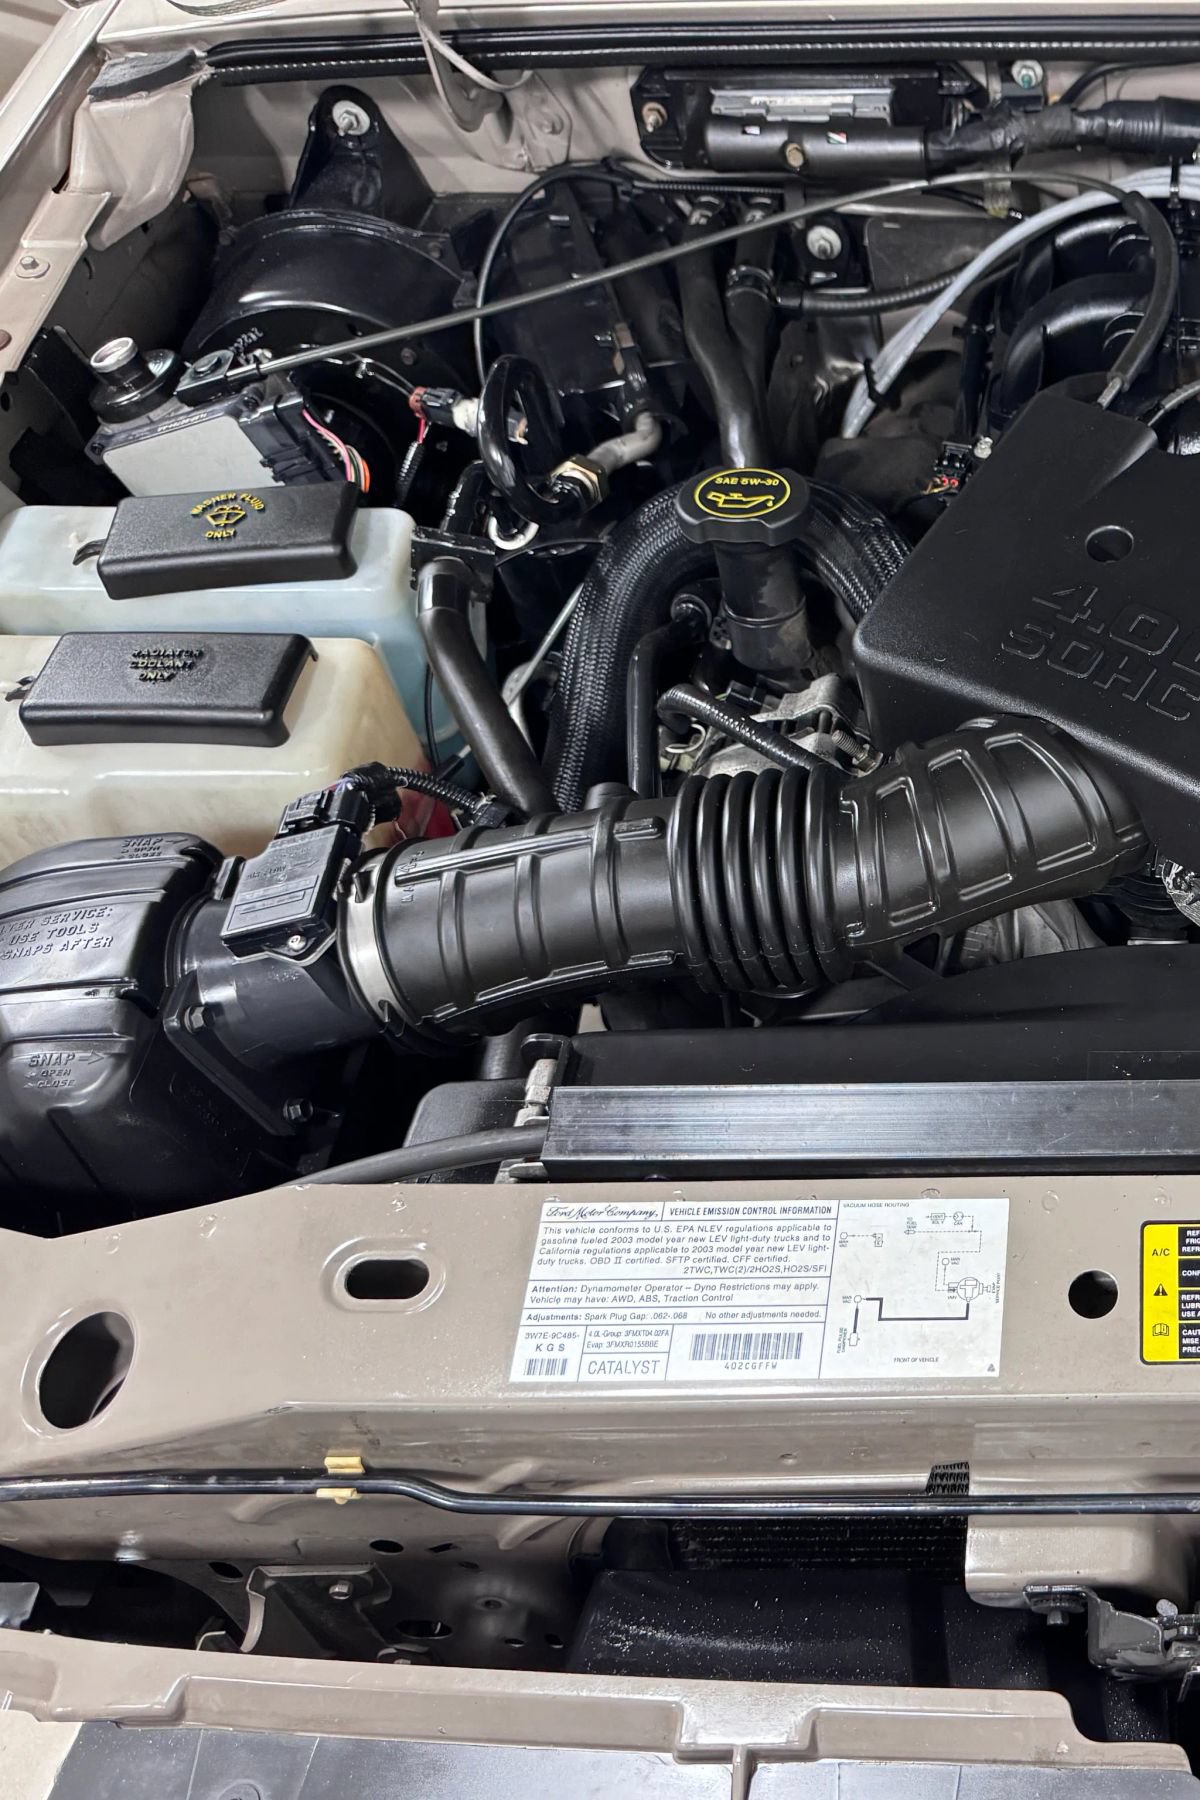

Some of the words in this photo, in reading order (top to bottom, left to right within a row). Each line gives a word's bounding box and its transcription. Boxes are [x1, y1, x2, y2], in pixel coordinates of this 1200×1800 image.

[740, 478, 780, 486] 5W-30
[205, 528, 236, 539] ONLY
[130, 659, 195, 669] COOLANT
[139, 671, 176, 682] ONLY
[41, 906, 113, 926] SERVICE:
[10, 932, 40, 946] USE
[48, 922, 100, 940] TOOLS
[1, 944, 54, 960] SNAPS
[59, 936, 113, 952] AFTER
[28, 1053, 76, 1068] SNAP
[546, 1206, 574, 1217] Ford
[569, 1206, 605, 1220] Motor
[670, 1208, 701, 1216] VEHICLE
[703, 1207, 739, 1215] EMISSION
[742, 1207, 777, 1215] CONTROL
[780, 1206, 831, 1215] INFORMATION
[654, 1225, 672, 1233] U.S.
[725, 1225, 773, 1233] regulations
[777, 1224, 820, 1232] applicable
[541, 1237, 577, 1246] gasoline
[666, 1237, 685, 1245] year
[730, 1235, 770, 1244] light-duty
[1152, 1248, 1170, 1256] A/C
[581, 1285, 641, 1294] Dynamometer
[645, 1284, 683, 1293] Operator
[694, 1284, 716, 1292] Dyno
[774, 1284, 791, 1292] may
[794, 1283, 818, 1291] apply.
[564, 1297, 581, 1305] may
[639, 1295, 660, 1303] ABS,
[526, 1314, 582, 1322] Adjustments:
[584, 1313, 607, 1321] Spark
[610, 1313, 627, 1321] Plug
[629, 1313, 648, 1321] Gap:
[741, 1311, 788, 1320] adjustments
[587, 1360, 660, 1374] CATALYST
